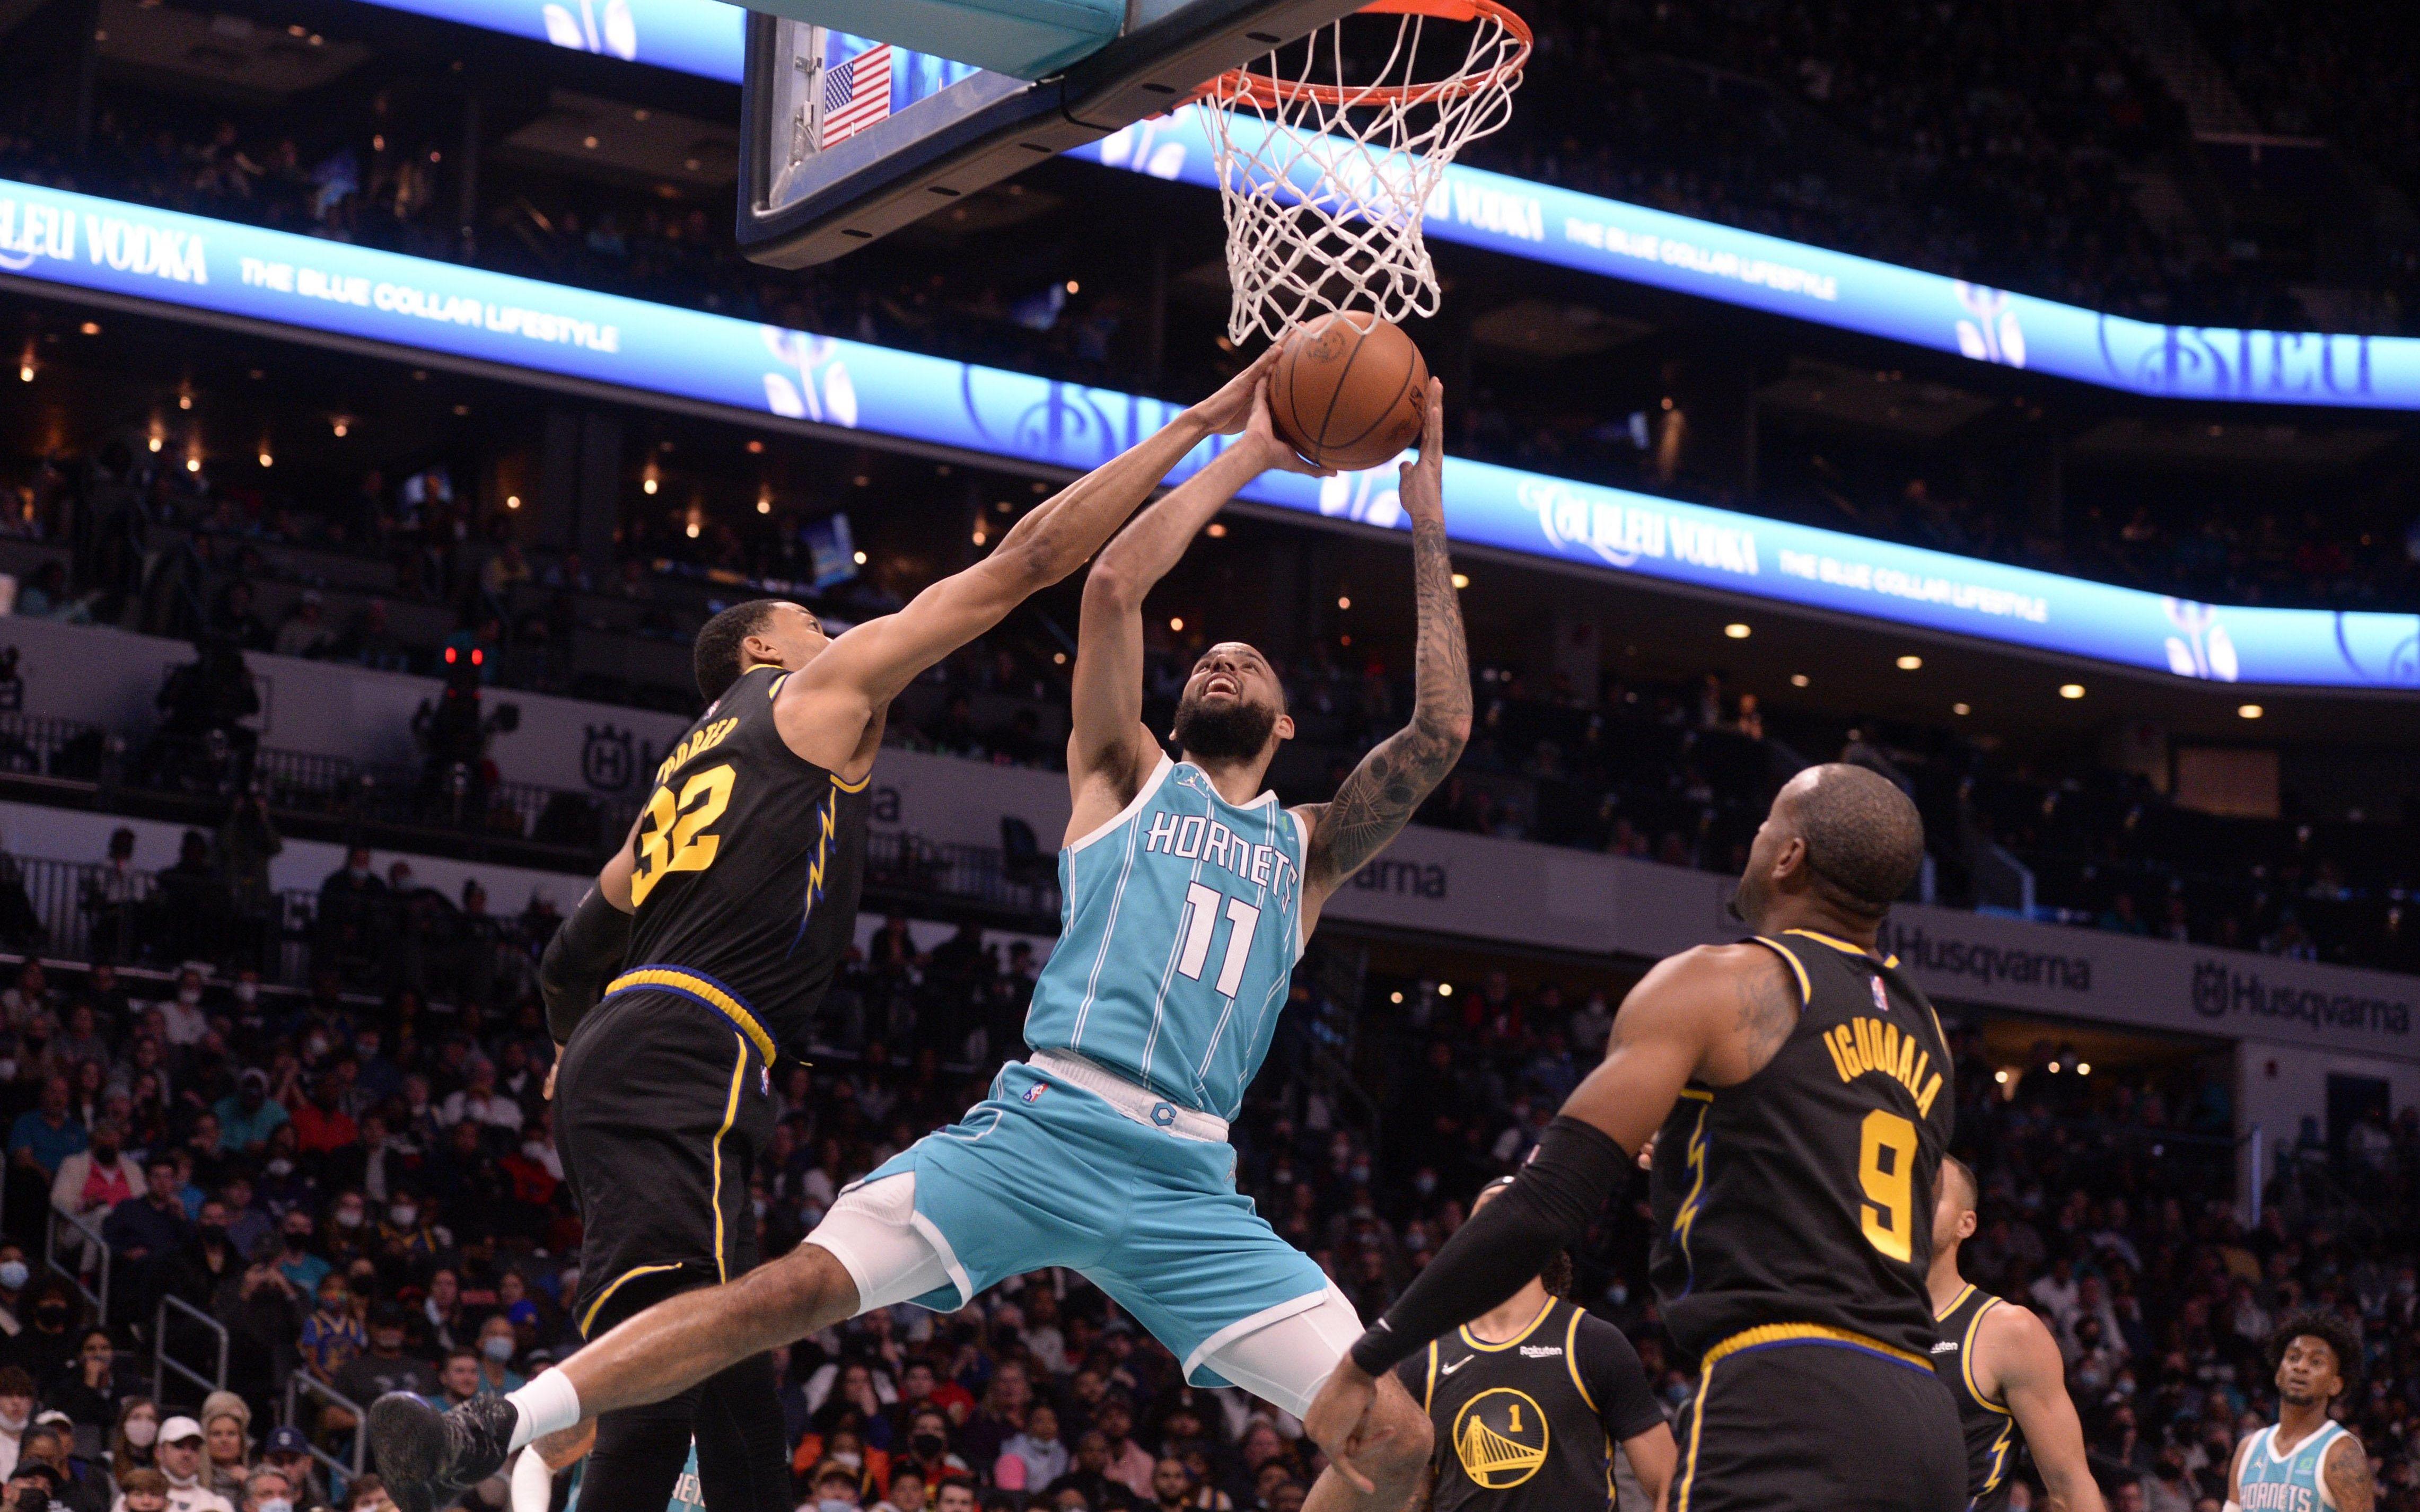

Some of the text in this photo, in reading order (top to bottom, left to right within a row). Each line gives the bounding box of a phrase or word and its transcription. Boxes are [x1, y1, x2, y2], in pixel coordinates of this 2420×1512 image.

[85, 214, 209, 285] VODKA
[1605, 226, 1661, 261] BLUE
[1660, 239, 1741, 278] COLLAR
[1741, 258, 1837, 302] LIFESTYLE
[241, 257, 619, 354] THE BLUE COLLAR LIFESTYLE
[1668, 514, 1760, 576] VODKA
[1779, 548, 2048, 623] THE BLUE COLLAR LIFESTYLE
[631, 763, 736, 907] 32
[1144, 811, 1298, 918] HORNETS
[1177, 880, 1261, 1000] 11
[2231, 970, 2410, 1035] Husqvarna
[1822, 1017, 1943, 1120] IGUODALA
[1858, 1109, 1918, 1263] 9
[1520, 1345, 1563, 1358] Rakuten
[1509, 1404, 1523, 1432] 1
[2239, 1482, 2312, 1512] HORNETS
